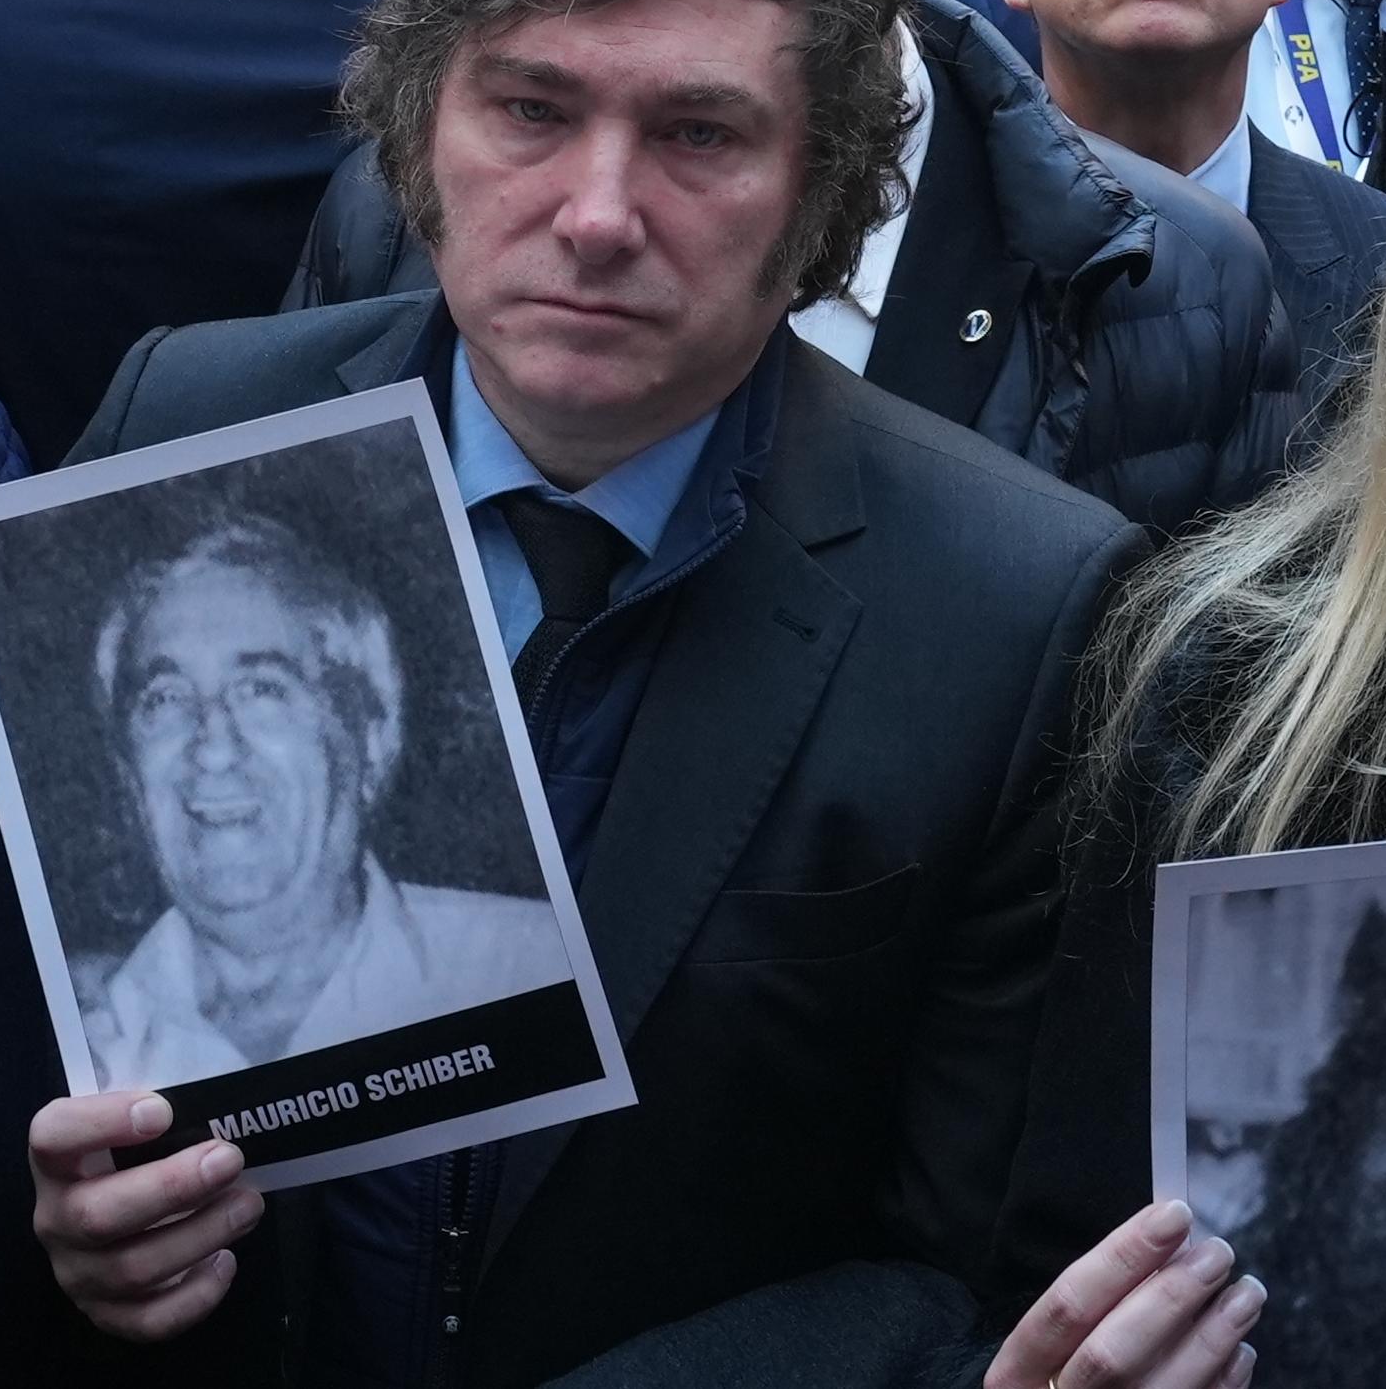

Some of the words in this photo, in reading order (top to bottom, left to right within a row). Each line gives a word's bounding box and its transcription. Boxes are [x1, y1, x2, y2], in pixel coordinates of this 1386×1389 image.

[1288, 34, 1321, 84] PFA
[208, 1081, 361, 1141] MAURICIO
[364, 1044, 496, 1102] SCHIBER
